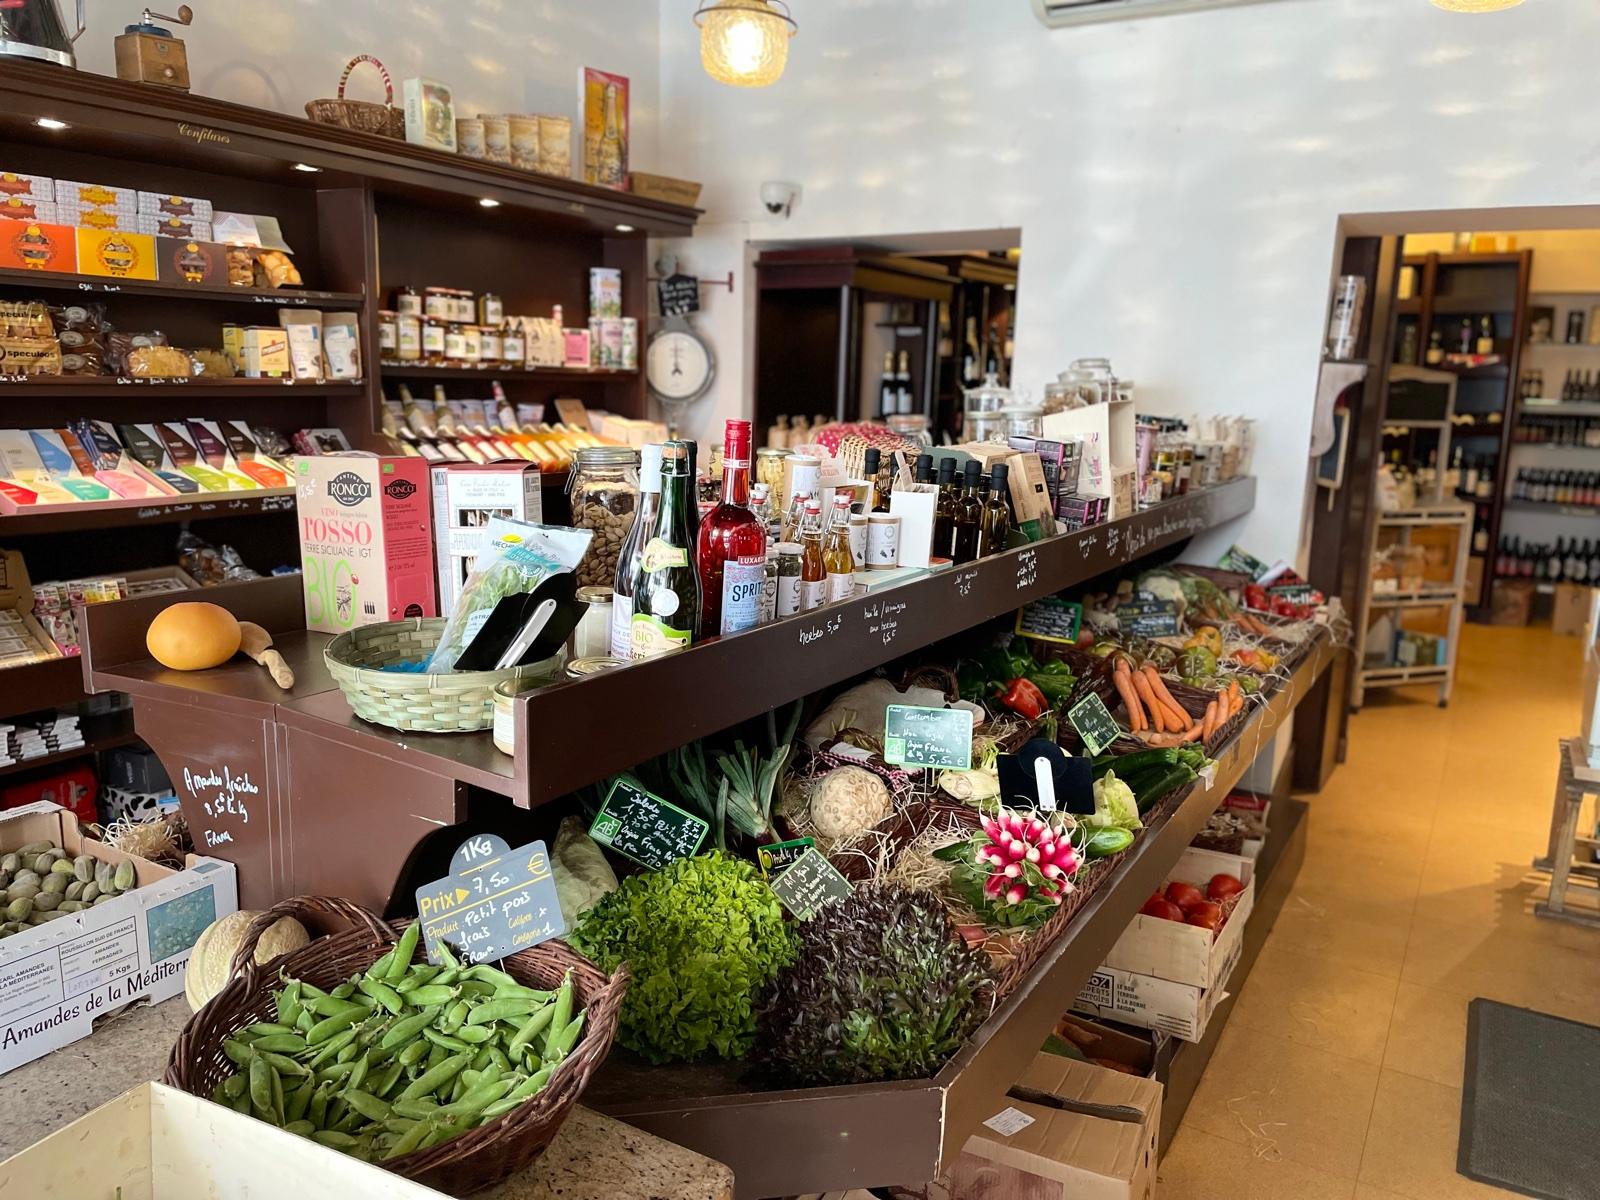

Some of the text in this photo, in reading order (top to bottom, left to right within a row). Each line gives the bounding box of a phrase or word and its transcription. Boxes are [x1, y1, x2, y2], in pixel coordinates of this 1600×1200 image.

[177, 122, 231, 144] Confitures
[7, 349, 56, 359] speculoos
[331, 483, 368, 497] RONCO
[387, 485, 416, 495] RONCO
[320, 544, 354, 557] SICILIANE
[304, 556, 357, 627] BIO
[595, 820, 615, 836] AB
[461, 837, 493, 863] 1Kg
[527, 852, 548, 875] €
[420, 871, 510, 918] Prix 7,50
[464, 900, 497, 927] Petit
[502, 890, 531, 918] pois
[113, 923, 134, 936] FRANCE
[458, 926, 491, 951] frais
[94, 942, 120, 955] AMANDES
[15, 962, 45, 977] AMANDES
[115, 964, 131, 976] Kgs
[2, 1003, 80, 1050] Amandes
[85, 993, 103, 1012] de
[108, 986, 121, 1002] la
[127, 957, 189, 995] Méditerr
[1078, 992, 1110, 1004] erroirs
